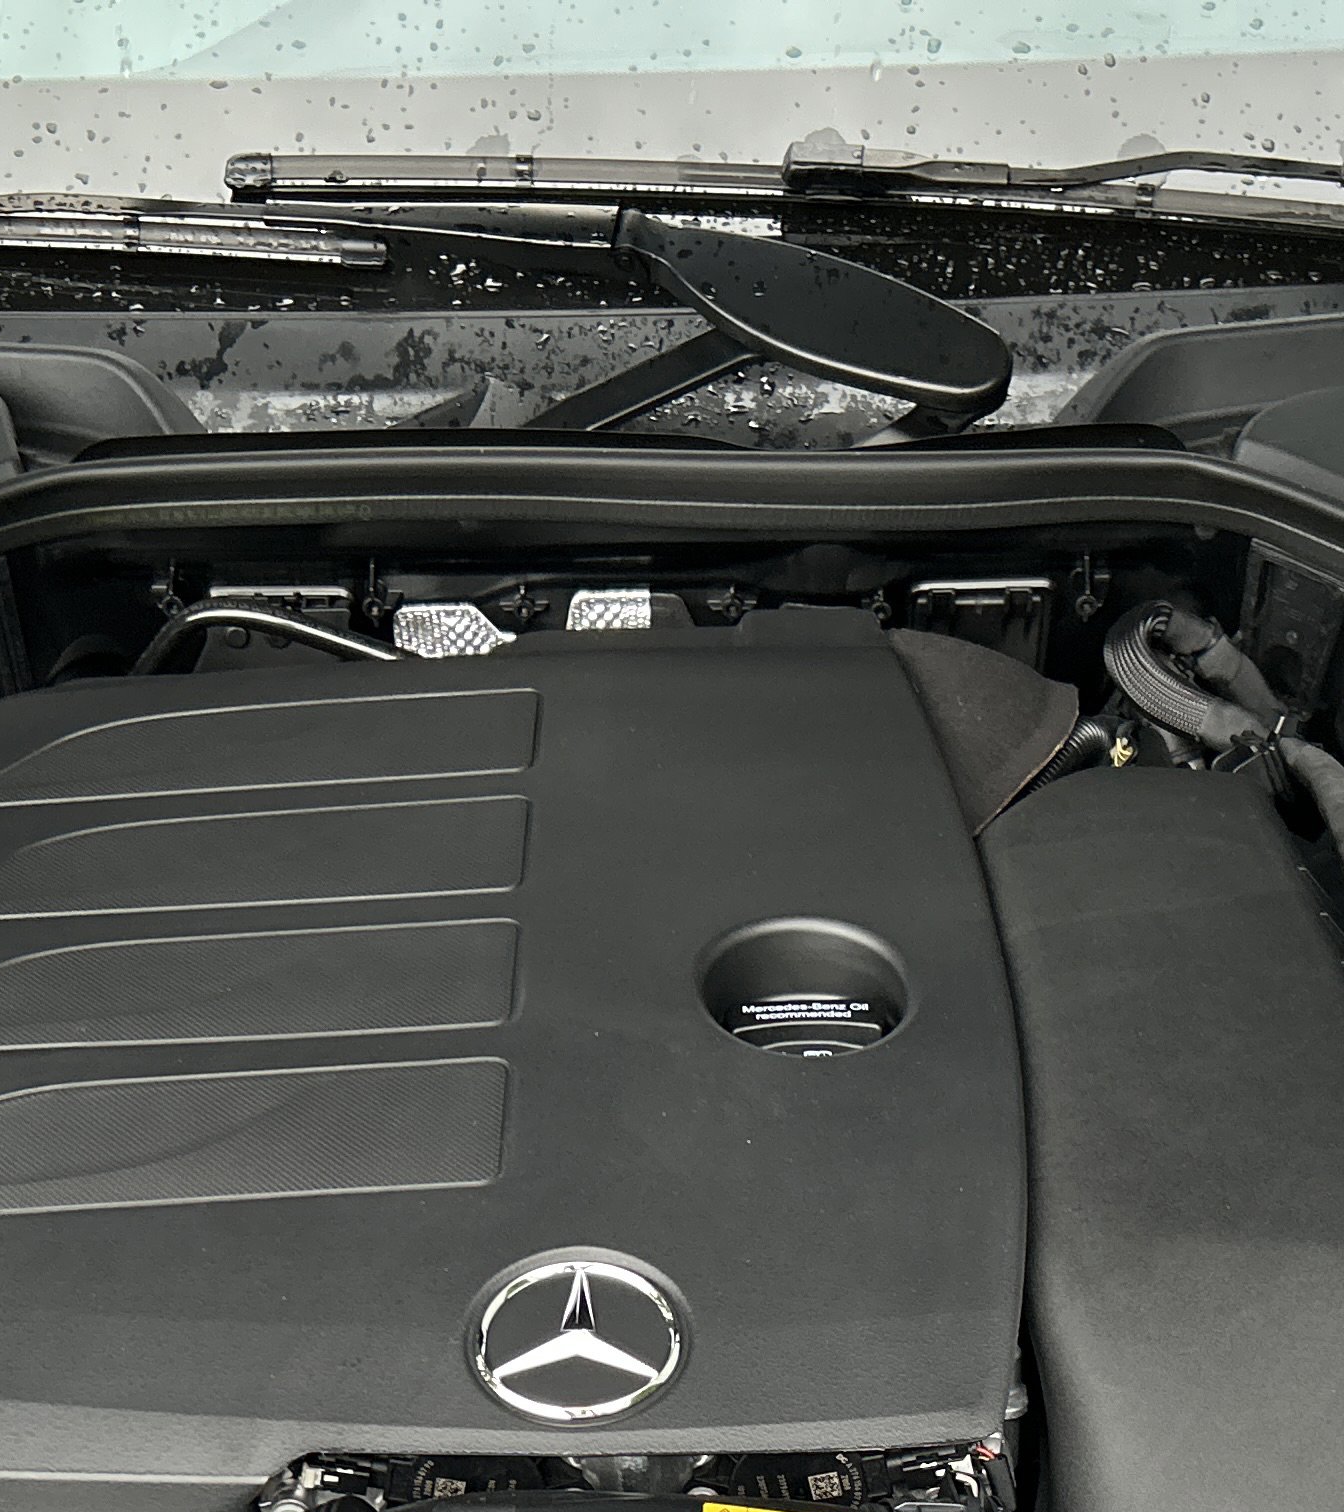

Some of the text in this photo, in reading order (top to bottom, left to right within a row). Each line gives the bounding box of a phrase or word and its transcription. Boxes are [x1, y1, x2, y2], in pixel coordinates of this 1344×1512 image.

[741, 1002, 869, 1013] Mercedes-Benz Oil
[755, 1010, 852, 1020] recommended
